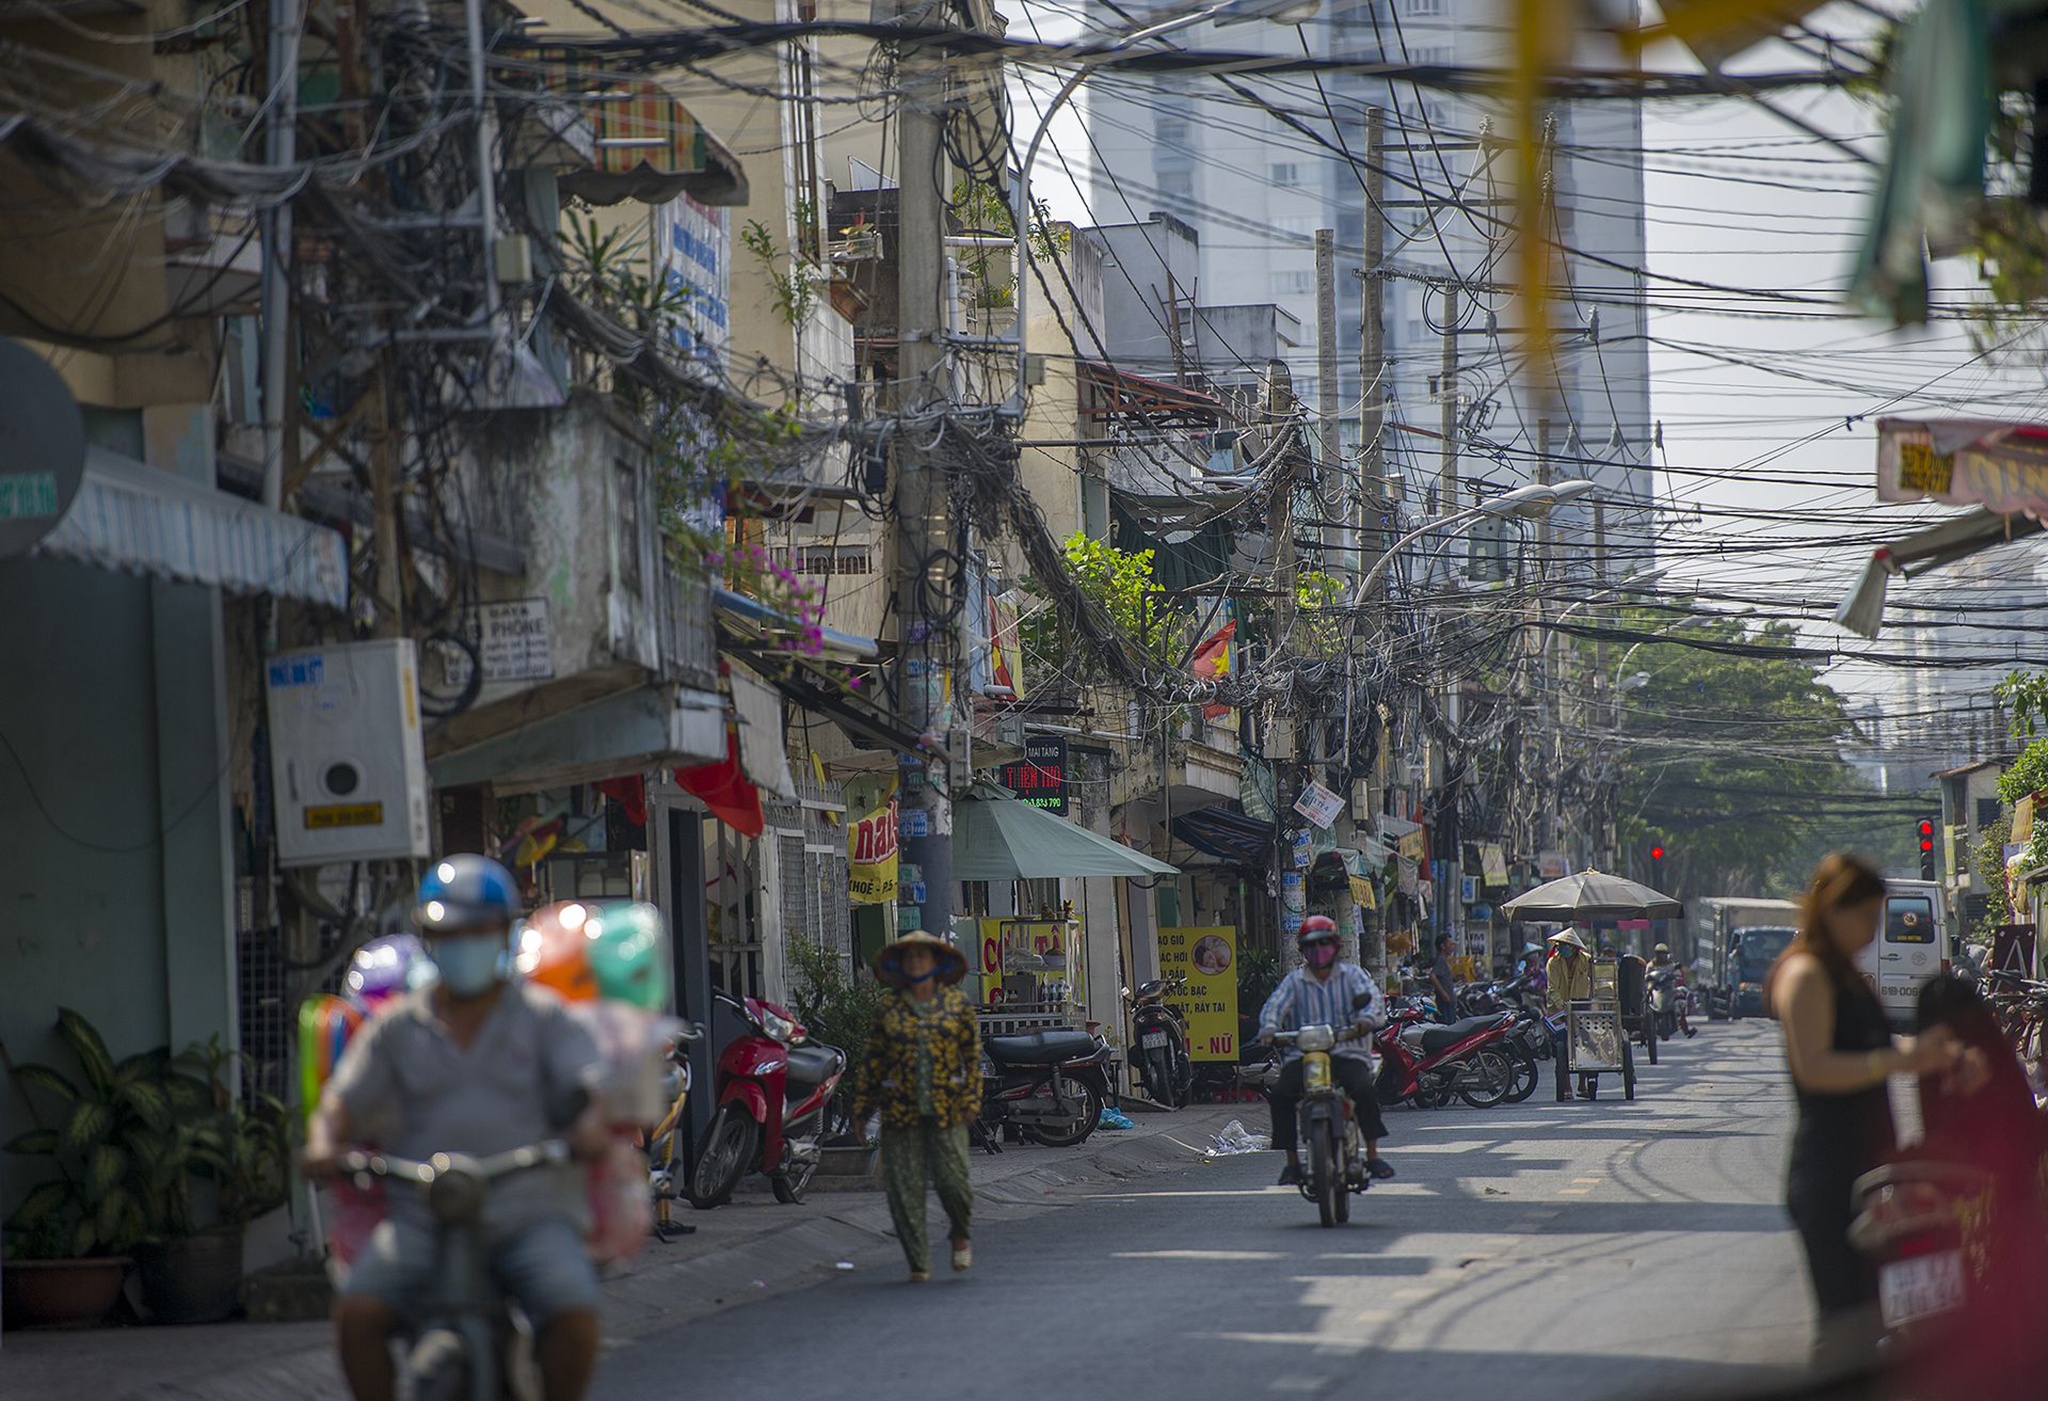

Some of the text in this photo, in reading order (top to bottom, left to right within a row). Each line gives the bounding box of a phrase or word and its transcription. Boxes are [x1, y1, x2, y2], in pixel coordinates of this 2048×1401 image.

[1881, 986, 1920, 997] 61B-006
[1213, 1002, 1226, 1013] TAI
[1210, 1032, 1233, 1054] NỮ
